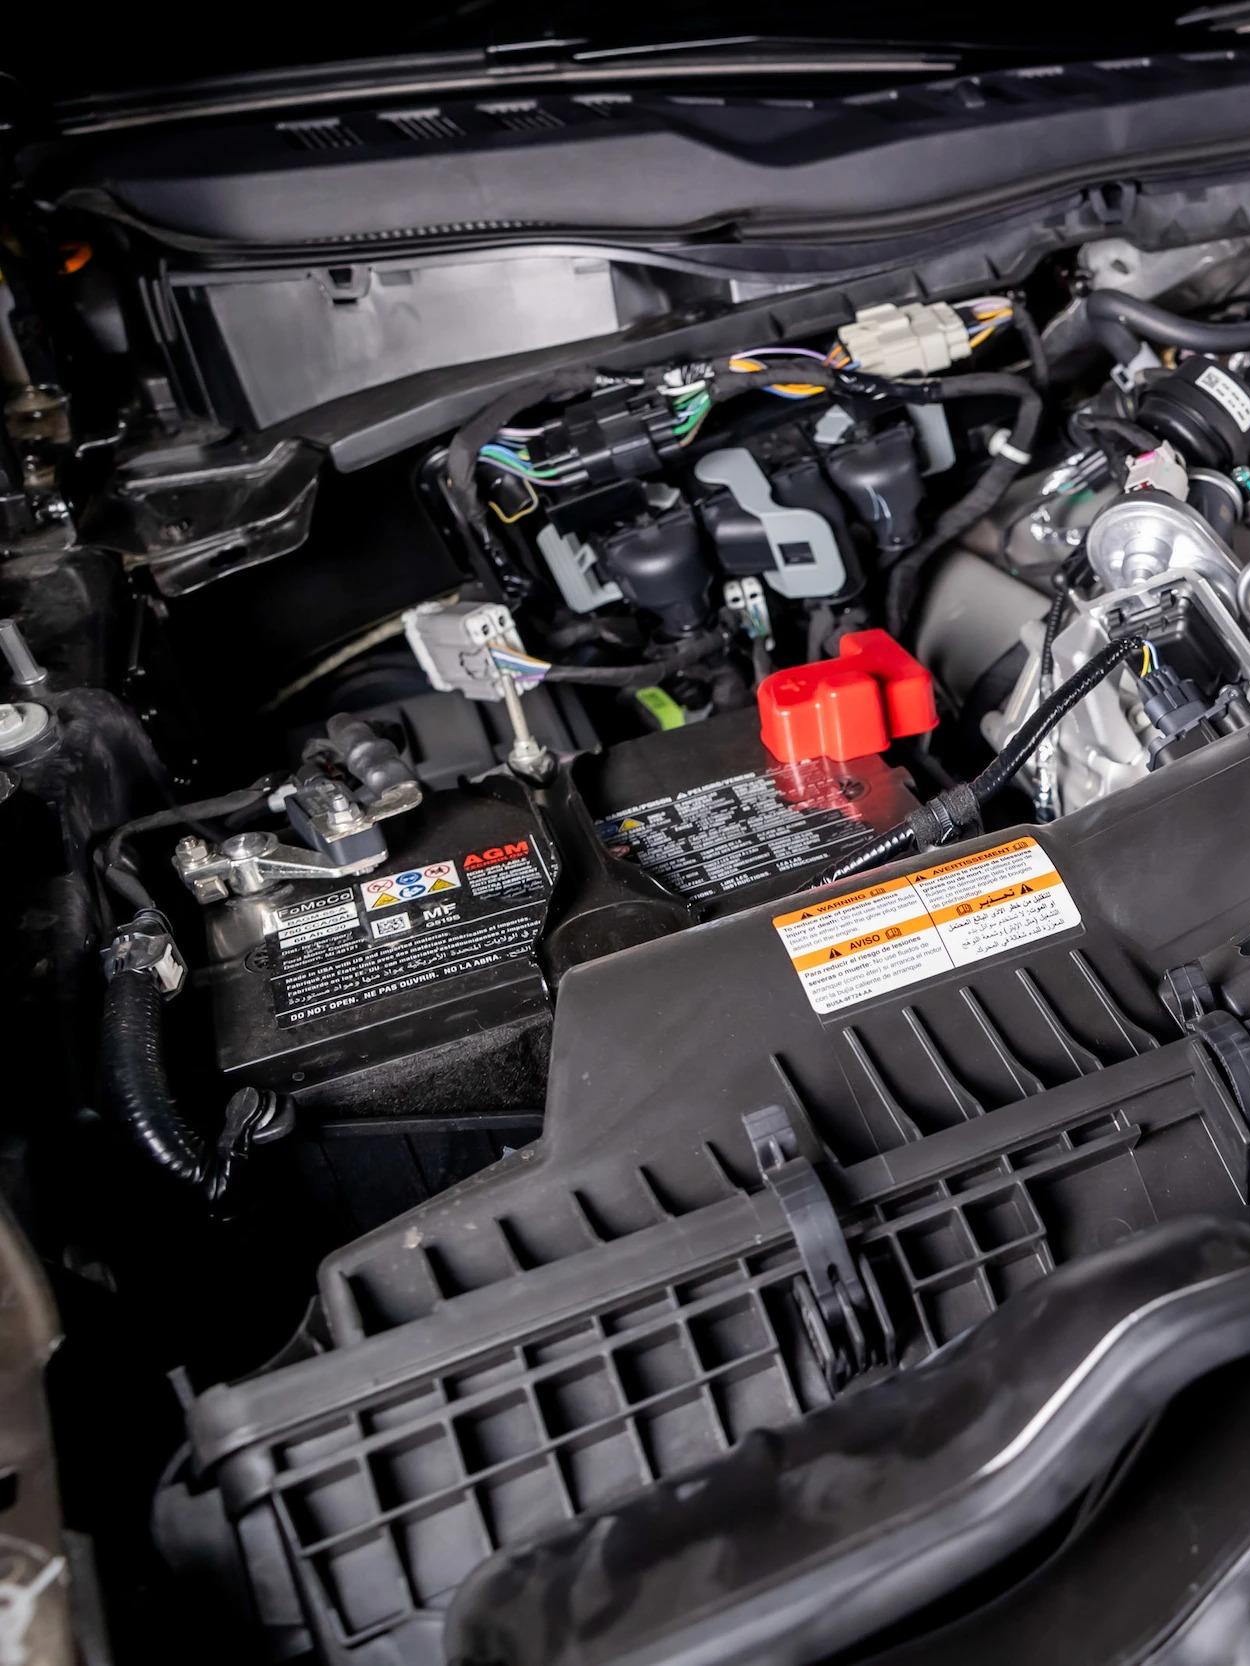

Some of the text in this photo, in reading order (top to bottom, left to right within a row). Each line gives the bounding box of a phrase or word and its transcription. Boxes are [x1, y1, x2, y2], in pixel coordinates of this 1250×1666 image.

[463, 840, 529, 869] AGM
[919, 878, 935, 888] Pour
[937, 870, 960, 882] réduire
[969, 861, 989, 872] risque
[1000, 848, 1031, 861] blessures
[933, 846, 1009, 875] AVERTISSEMENT
[922, 882, 945, 893] graves
[1012, 856, 1023, 864] pas
[925, 886, 947, 898] fluides
[957, 872, 990, 888] démarrage
[954, 883, 976, 894] moteur
[1008, 865, 1031, 878] bougies
[279, 891, 350, 918] FoMoCo
[422, 901, 456, 921] MF
[794, 918, 817, 929] reduce
[819, 913, 830, 921] risk
[843, 900, 871, 914] possible
[873, 892, 897, 903] serious
[816, 894, 866, 912] WARNING
[931, 901, 939, 909] de
[283, 912, 352, 936] 750 CCA/SAE
[326, 923, 346, 933] C20
[787, 928, 806, 939] injury
[817, 918, 838, 928] death:
[840, 913, 850, 921] Do
[789, 934, 808, 945] (such
[840, 920, 853, 928] with
[866, 910, 881, 920] glow
[882, 905, 896, 916] plug
[377, 954, 393, 963] avec
[396, 949, 408, 957] des
[850, 933, 879, 950] AVISO
[285, 973, 306, 983] Made
[317, 965, 333, 974] USA
[335, 960, 350, 969] with
[352, 956, 363, 964] US
[364, 951, 378, 960] and
[380, 941, 412, 956] imported
[414, 930, 450, 946] materials.
[804, 968, 821, 979] Para
[823, 959, 847, 972] reducir
[858, 948, 880, 962] riesgo
[881, 945, 890, 953] de
[891, 935, 920, 949] lesiones
[808, 973, 836, 986] severas
[844, 960, 871, 974] muerte:
[873, 956, 882, 965] No
[884, 952, 896, 961] use
[897, 944, 919, 956] fluidos
[920, 941, 928, 949] de
[812, 980, 841, 996] arranque
[844, 972, 863, 985] (como
[890, 955, 914, 968] arranca
[923, 945, 941, 956] motor
[291, 952, 501, 1021] DO NOT OPEN. NE PAS OUVRIR. NO LA ABRA.
[815, 994, 827, 1003] con
[837, 983, 853, 996] bujía
[855, 975, 880, 989] caliente
[882, 971, 890, 980] de
[892, 961, 921, 976] arranque
